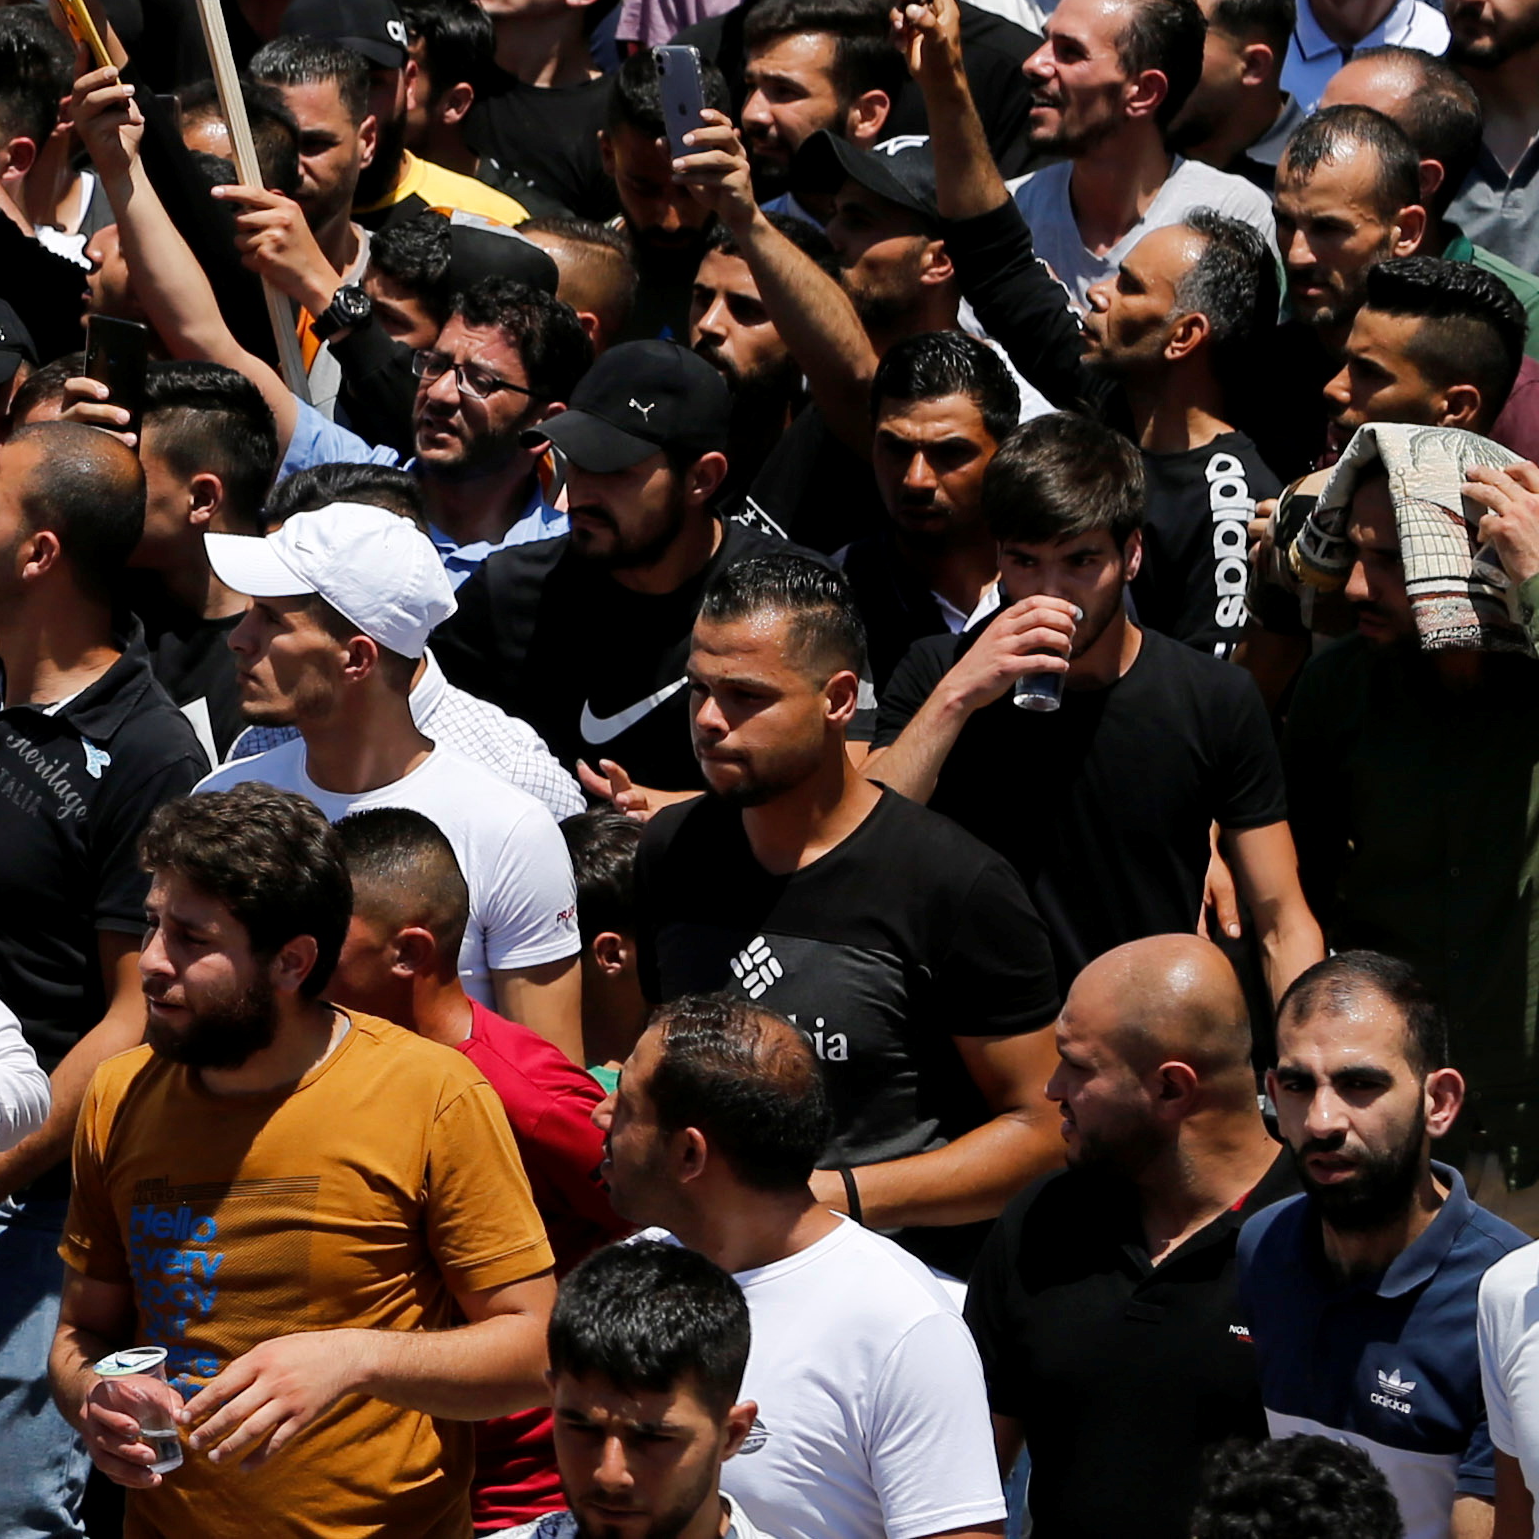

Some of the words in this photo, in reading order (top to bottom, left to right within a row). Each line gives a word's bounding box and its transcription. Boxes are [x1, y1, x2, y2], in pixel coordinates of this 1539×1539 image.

[1205, 453, 1256, 628] adidas
[129, 1205, 218, 1244] Hello
[1370, 1392, 1412, 1415] adidas
